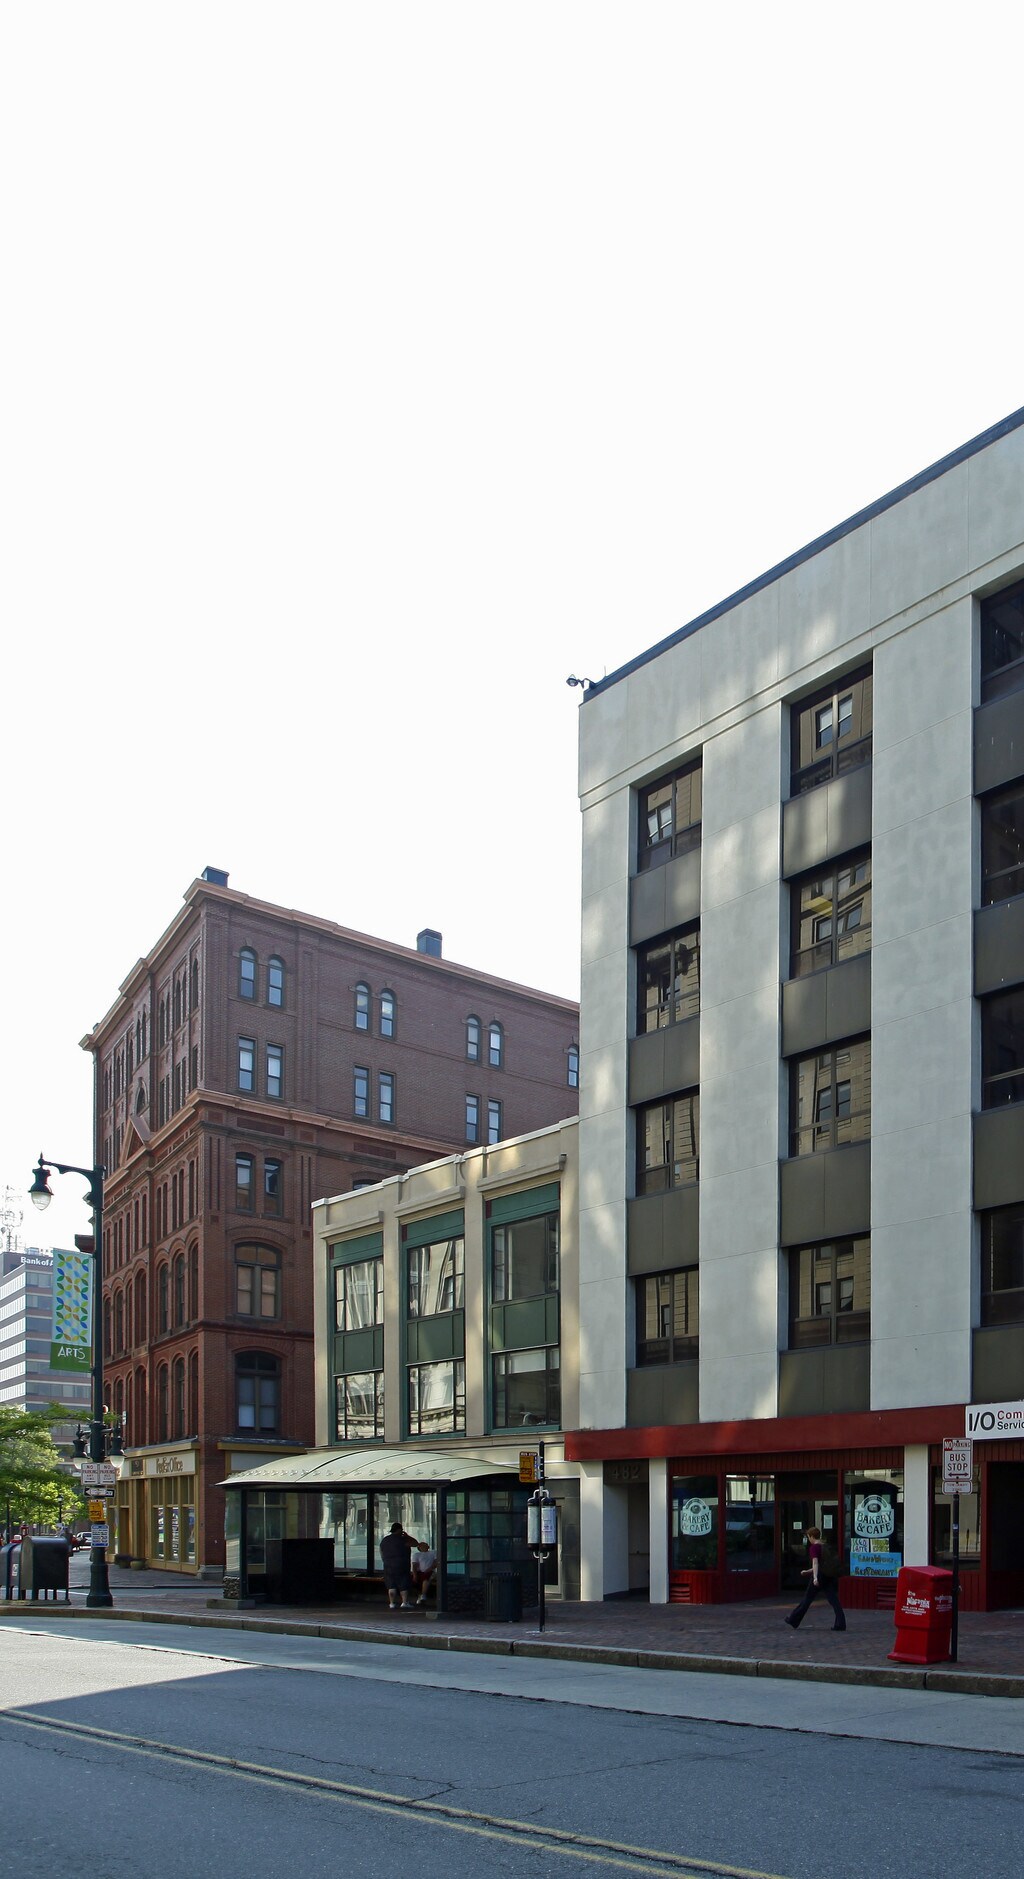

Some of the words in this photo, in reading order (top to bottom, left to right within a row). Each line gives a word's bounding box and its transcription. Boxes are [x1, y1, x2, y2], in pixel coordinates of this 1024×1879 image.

[20, 1256, 41, 1265] Bank
[57, 1346, 86, 1360] ARTS
[968, 1411, 996, 1431] I/O
[944, 1441, 953, 1450] NO
[950, 1453, 966, 1461] BUS
[947, 1463, 968, 1471] STOP
[682, 1512, 710, 1524] BAKERY
[857, 1511, 892, 1525] BAKERY
[690, 1522, 710, 1533] CAFE
[856, 1522, 866, 1532] &
[866, 1522, 892, 1535] CAFE
